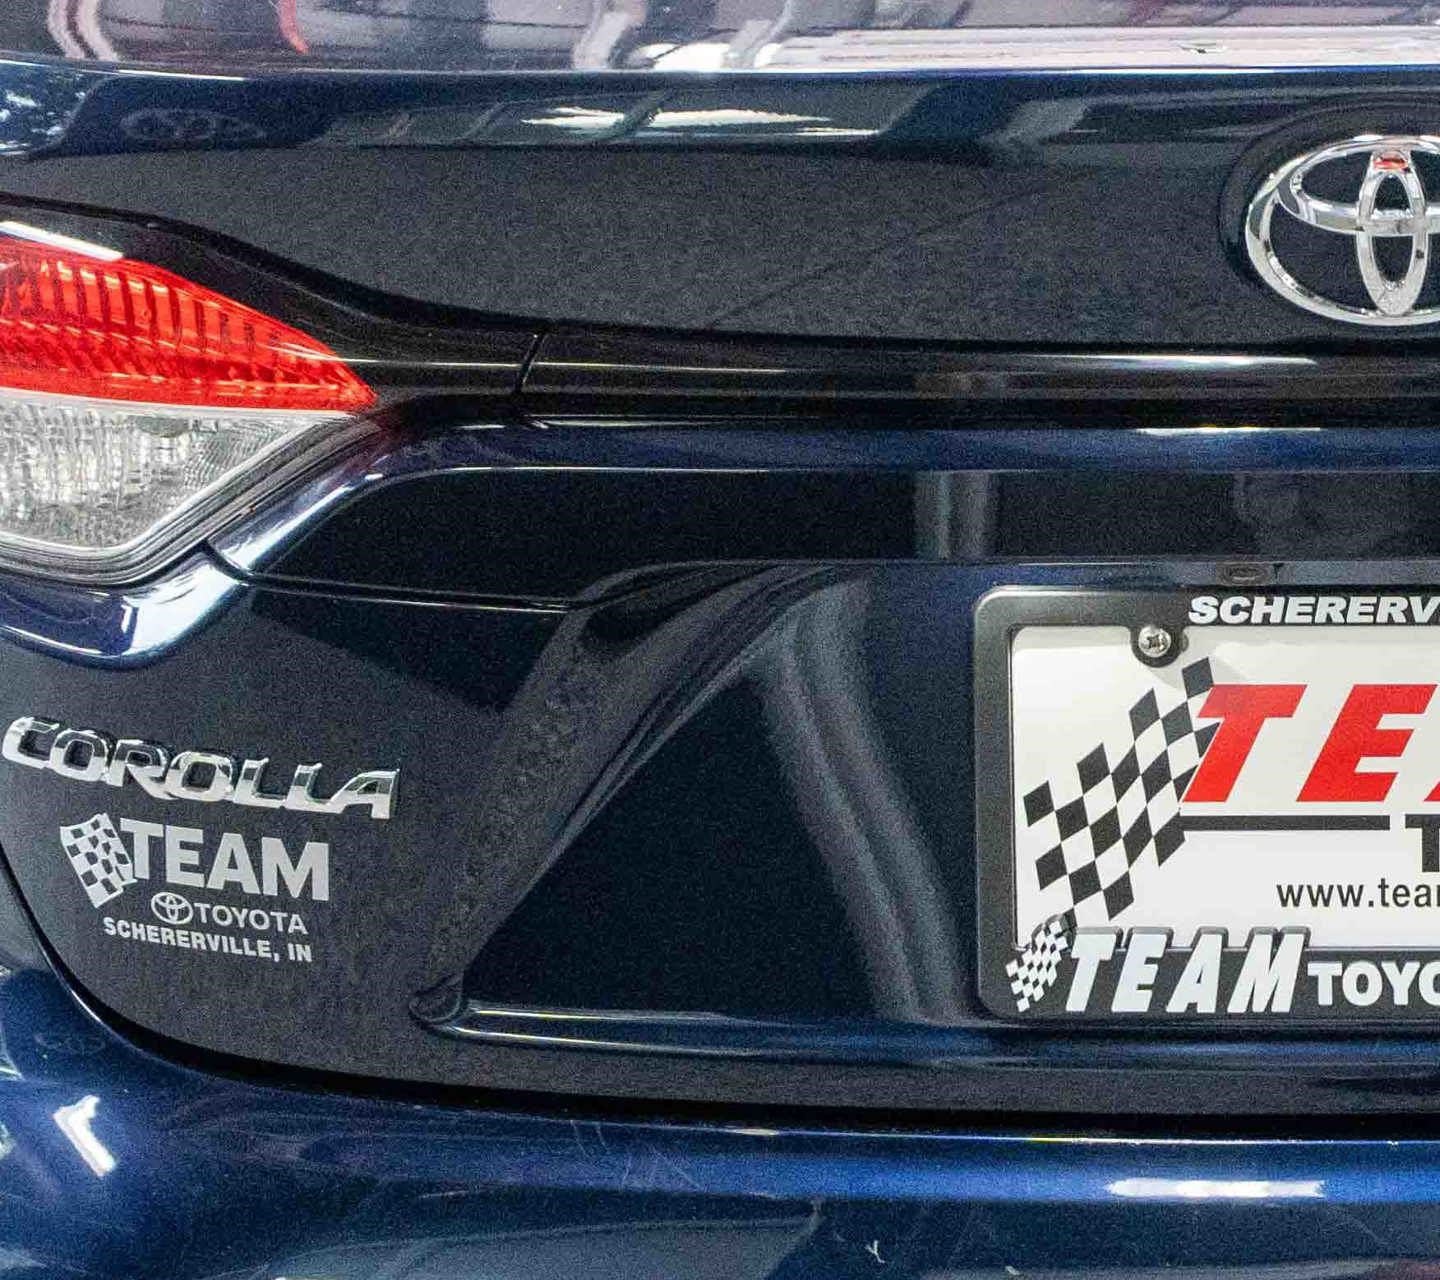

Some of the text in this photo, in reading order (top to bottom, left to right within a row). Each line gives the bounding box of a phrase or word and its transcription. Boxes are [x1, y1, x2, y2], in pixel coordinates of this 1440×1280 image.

[1, 714, 401, 820] COROLLA
[119, 817, 330, 902] TEAM
[102, 915, 313, 964] SCHERERVILLE, IN
[194, 902, 307, 936] TOYOTA
